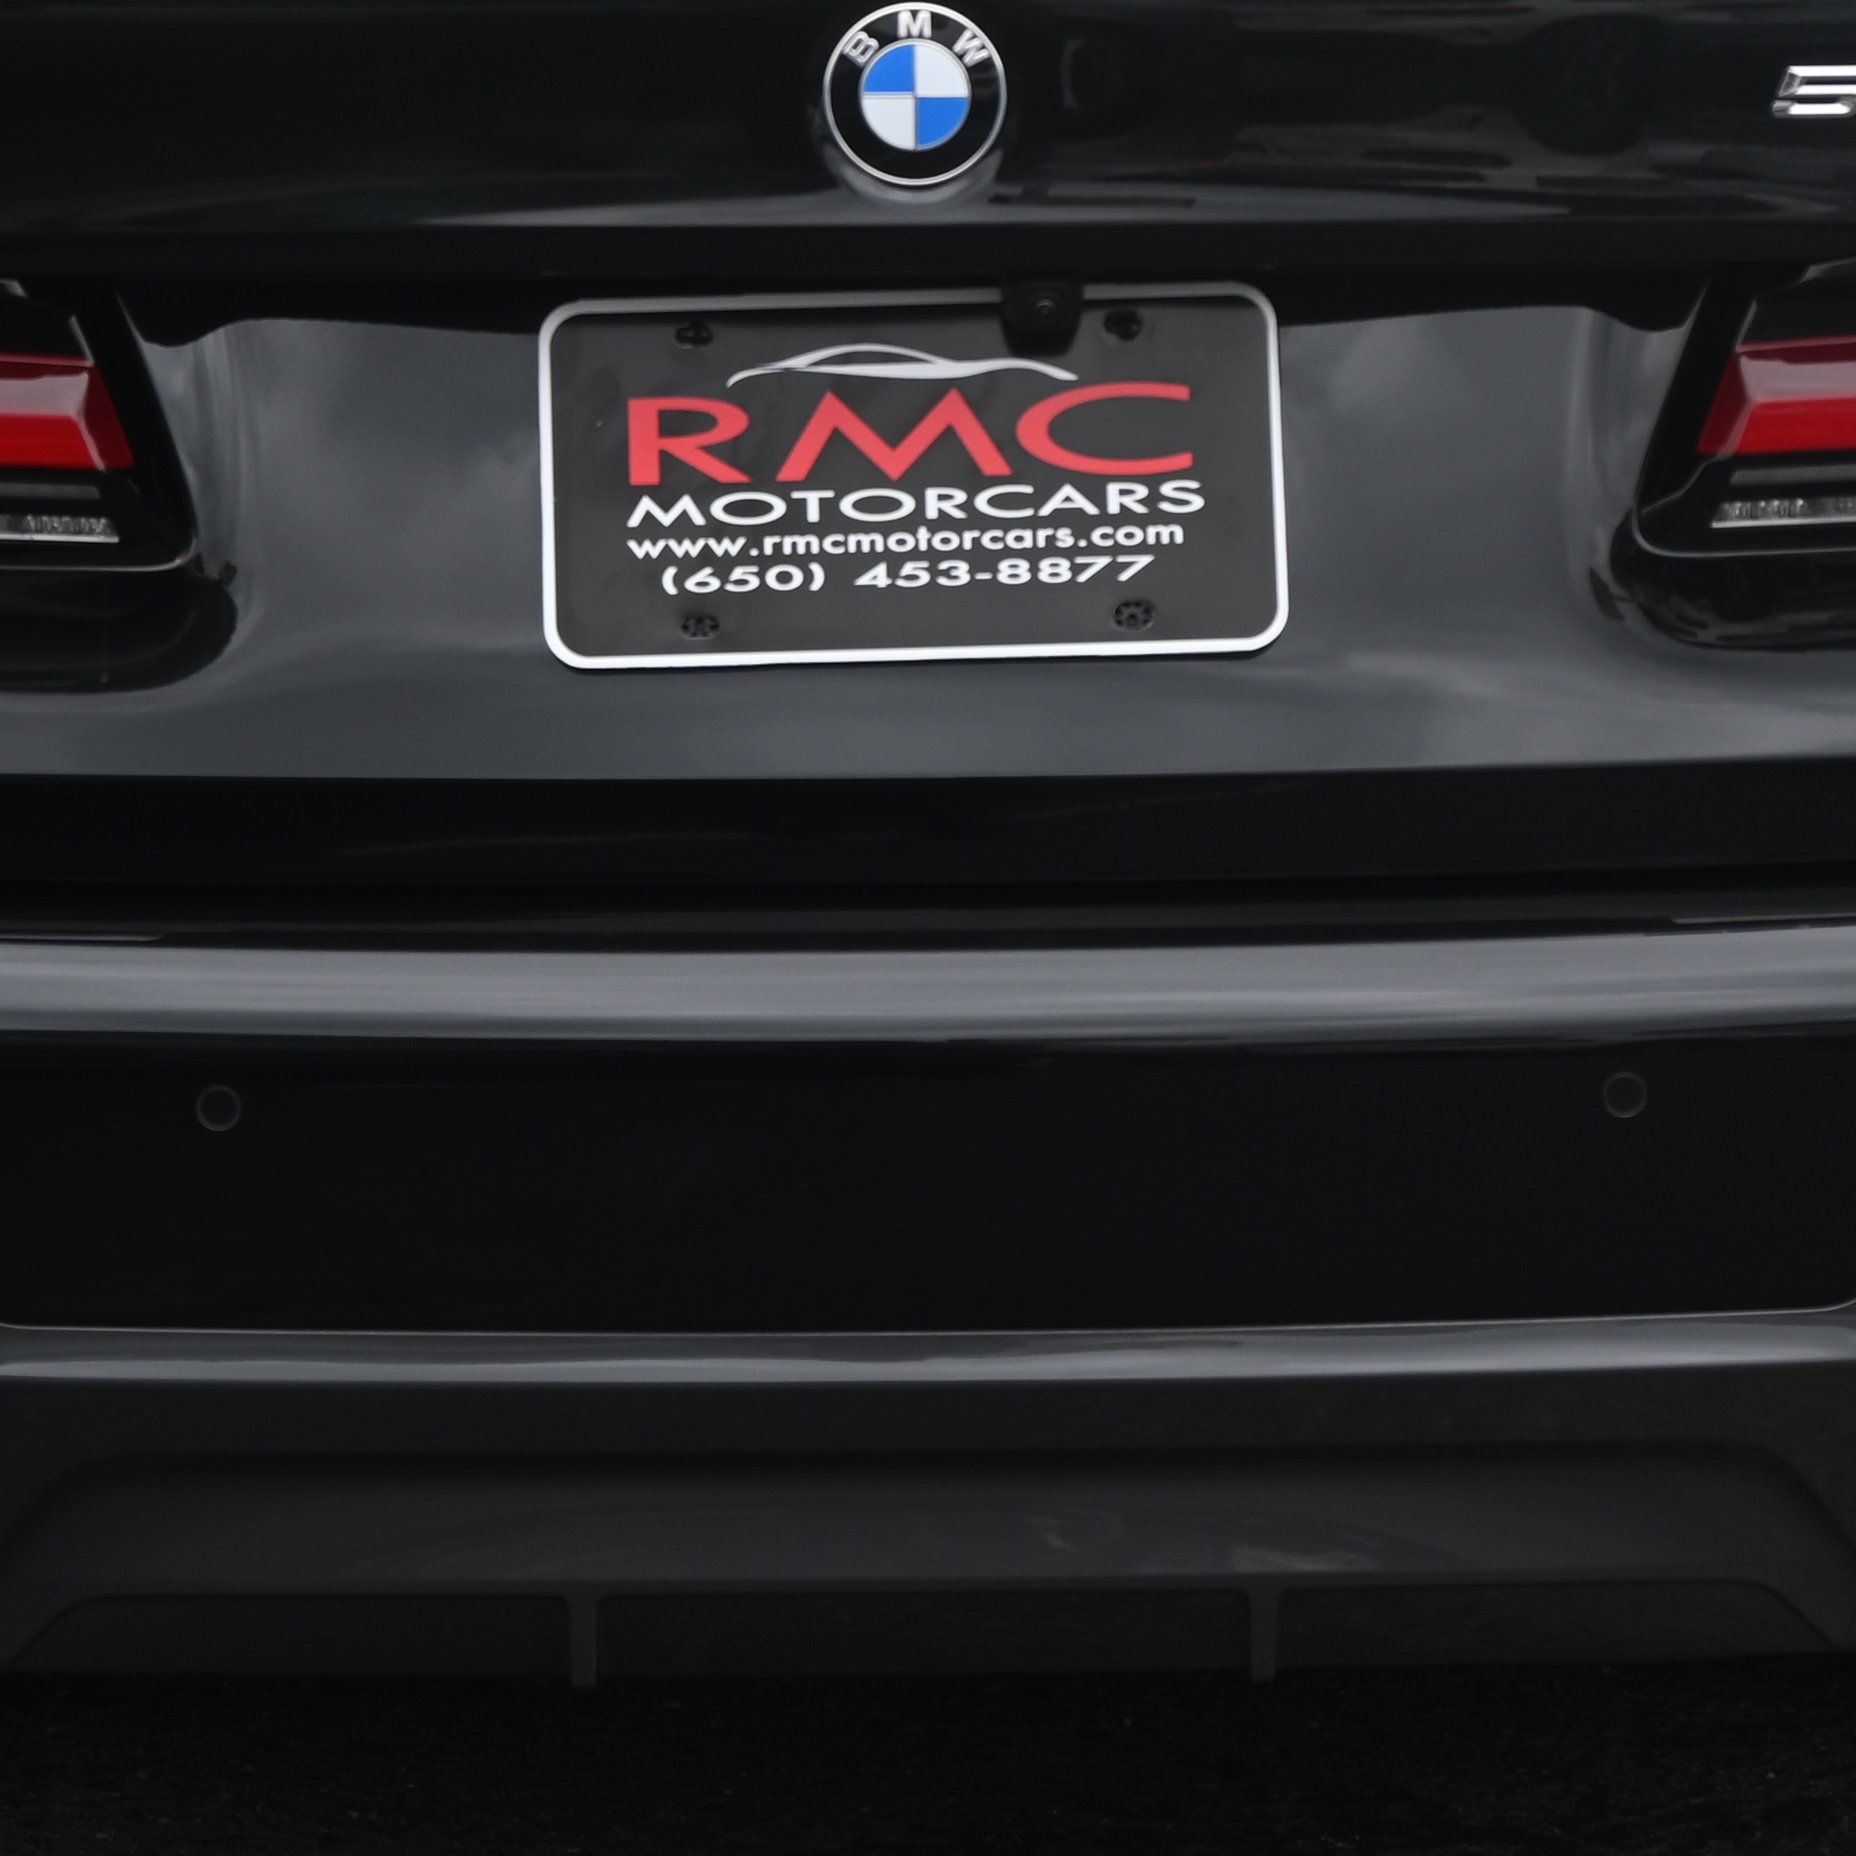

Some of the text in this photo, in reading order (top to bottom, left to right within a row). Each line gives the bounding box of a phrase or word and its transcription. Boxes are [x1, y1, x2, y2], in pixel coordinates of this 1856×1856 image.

[841, 9, 993, 70] BMW
[626, 380, 1195, 487] RMC
[626, 479, 1206, 528] MOTORCARS
[626, 523, 1185, 560] www.rmcmotorcars.com
[660, 553, 1156, 596] (650) 453-8877
